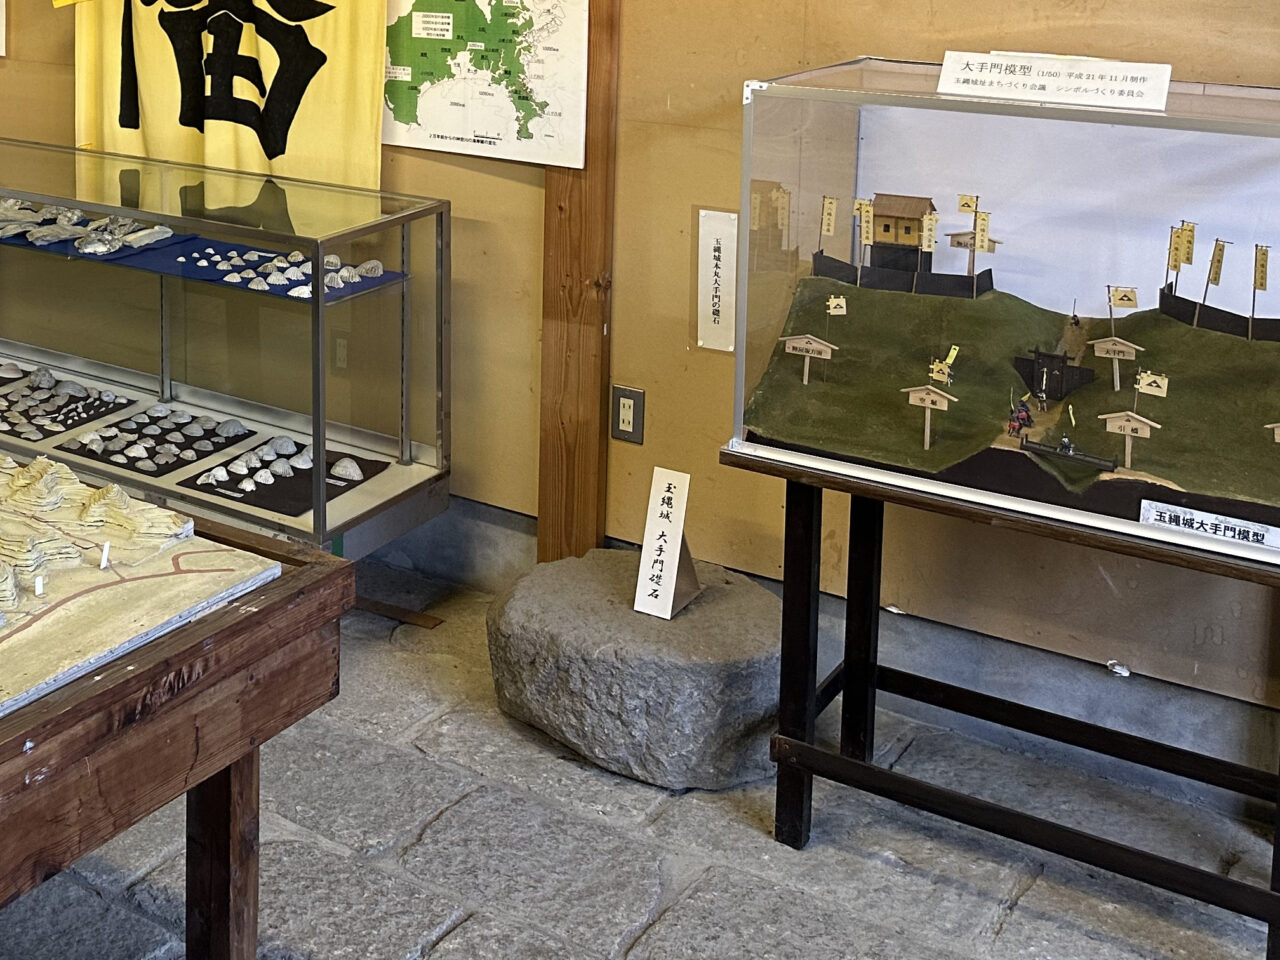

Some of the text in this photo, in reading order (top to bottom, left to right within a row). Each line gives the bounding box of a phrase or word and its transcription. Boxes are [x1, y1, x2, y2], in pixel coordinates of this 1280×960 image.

[960, 60, 1033, 77] 大手門模型
[647, 482, 677, 599] 玉縄城 大手門礎石
